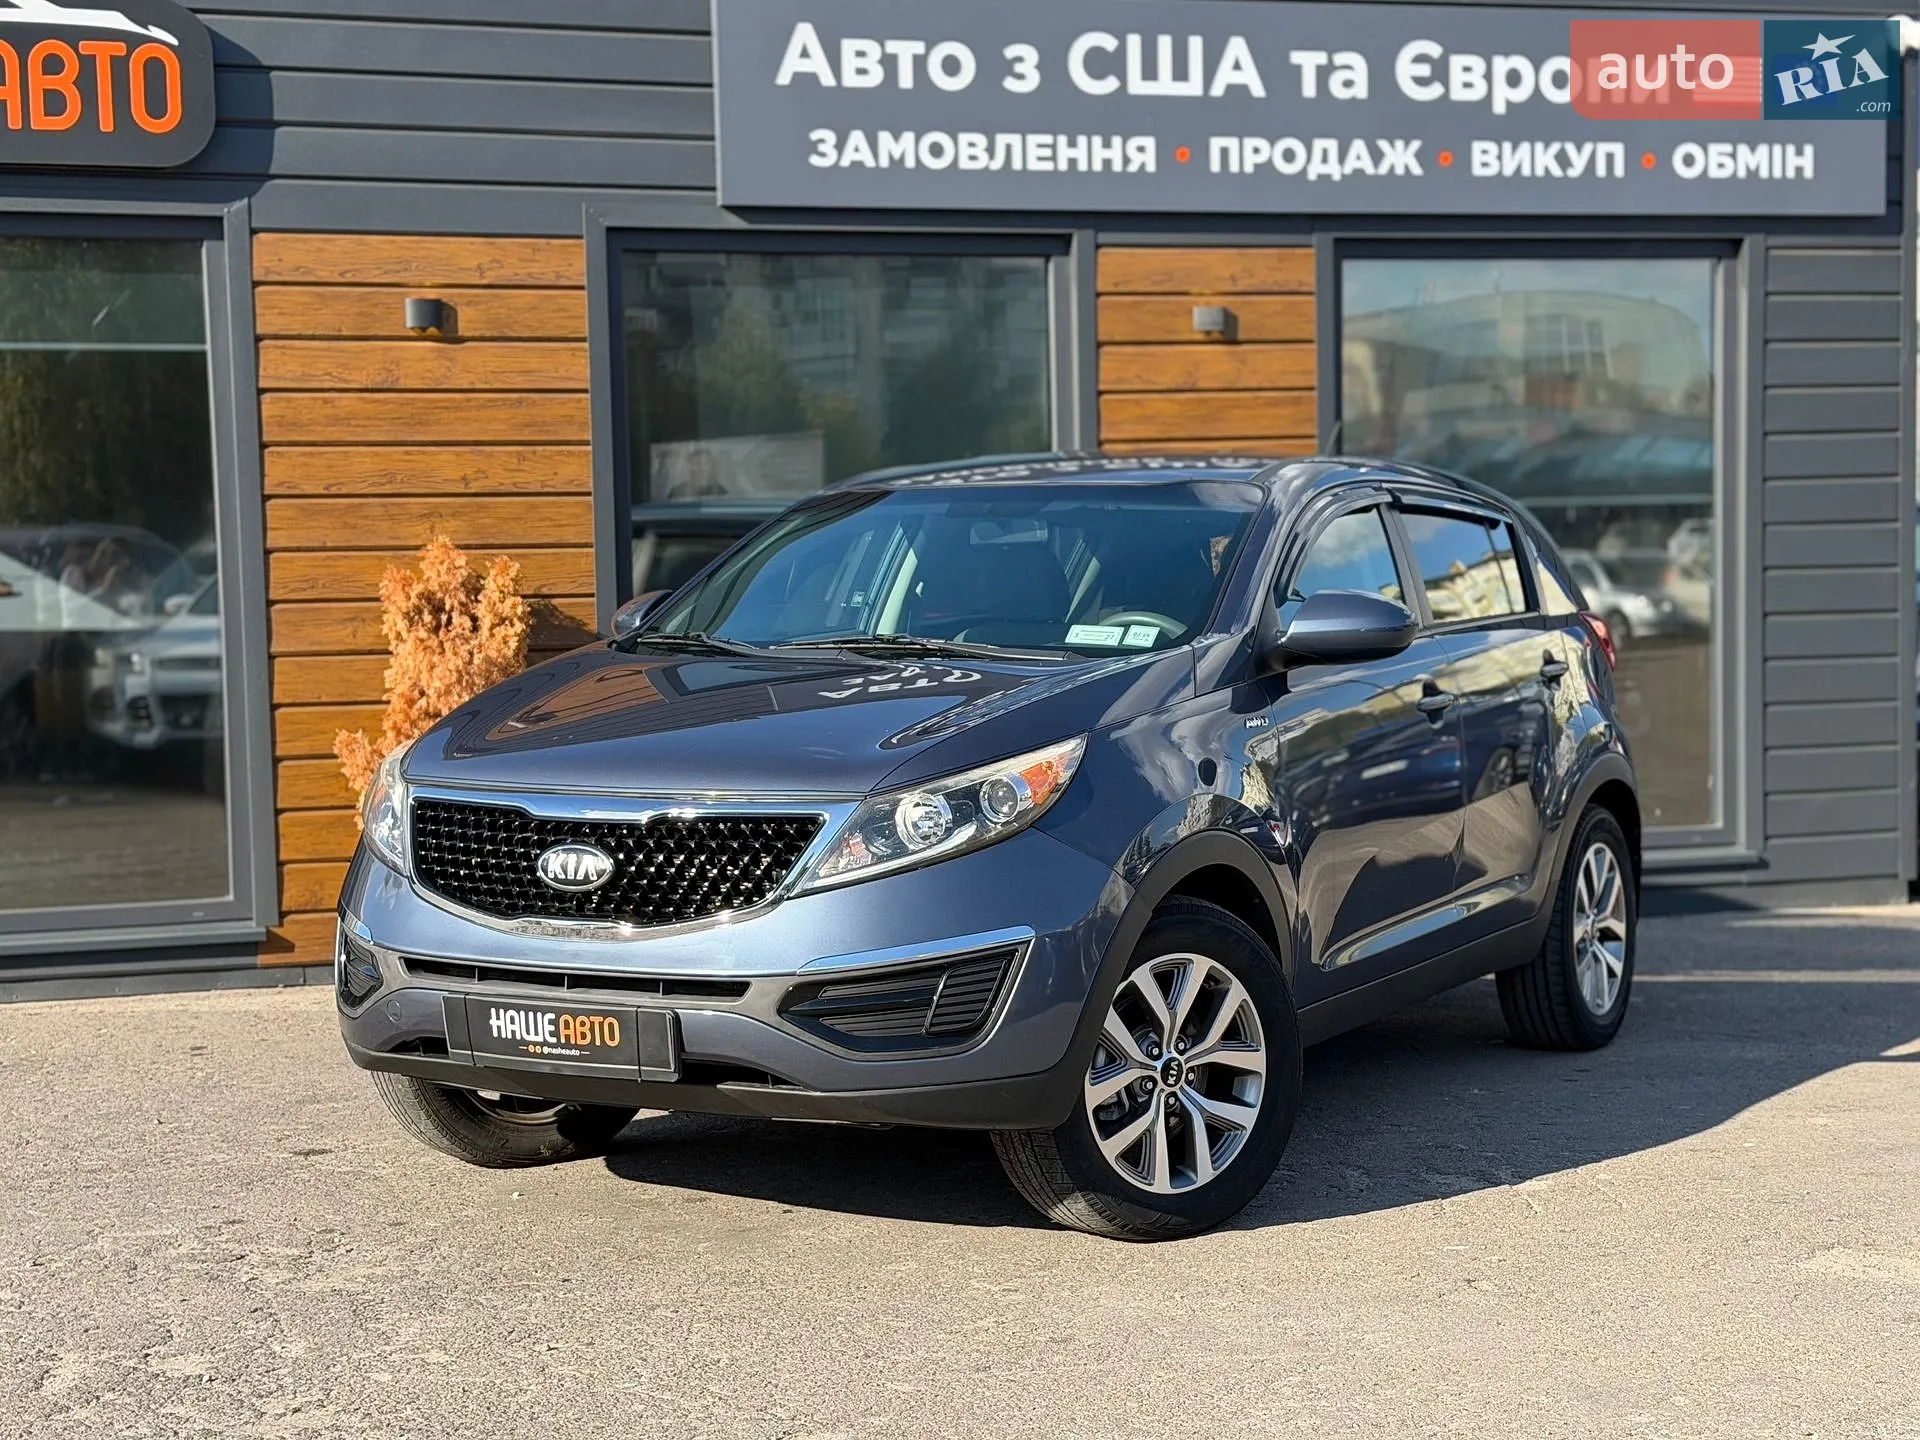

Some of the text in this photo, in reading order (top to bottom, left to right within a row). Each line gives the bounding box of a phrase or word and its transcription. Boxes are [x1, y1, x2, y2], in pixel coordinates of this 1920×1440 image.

[1068, 31, 1266, 98] США
[1290, 50, 1368, 100] та
[808, 128, 1814, 181] ЗАМОВЛЕННЯ ПРОДАЖ ВИКУП ОБМІН
[1245, 716, 1269, 729] AWD
[547, 853, 598, 881] KIA
[1167, 1060, 1179, 1085] KIA
